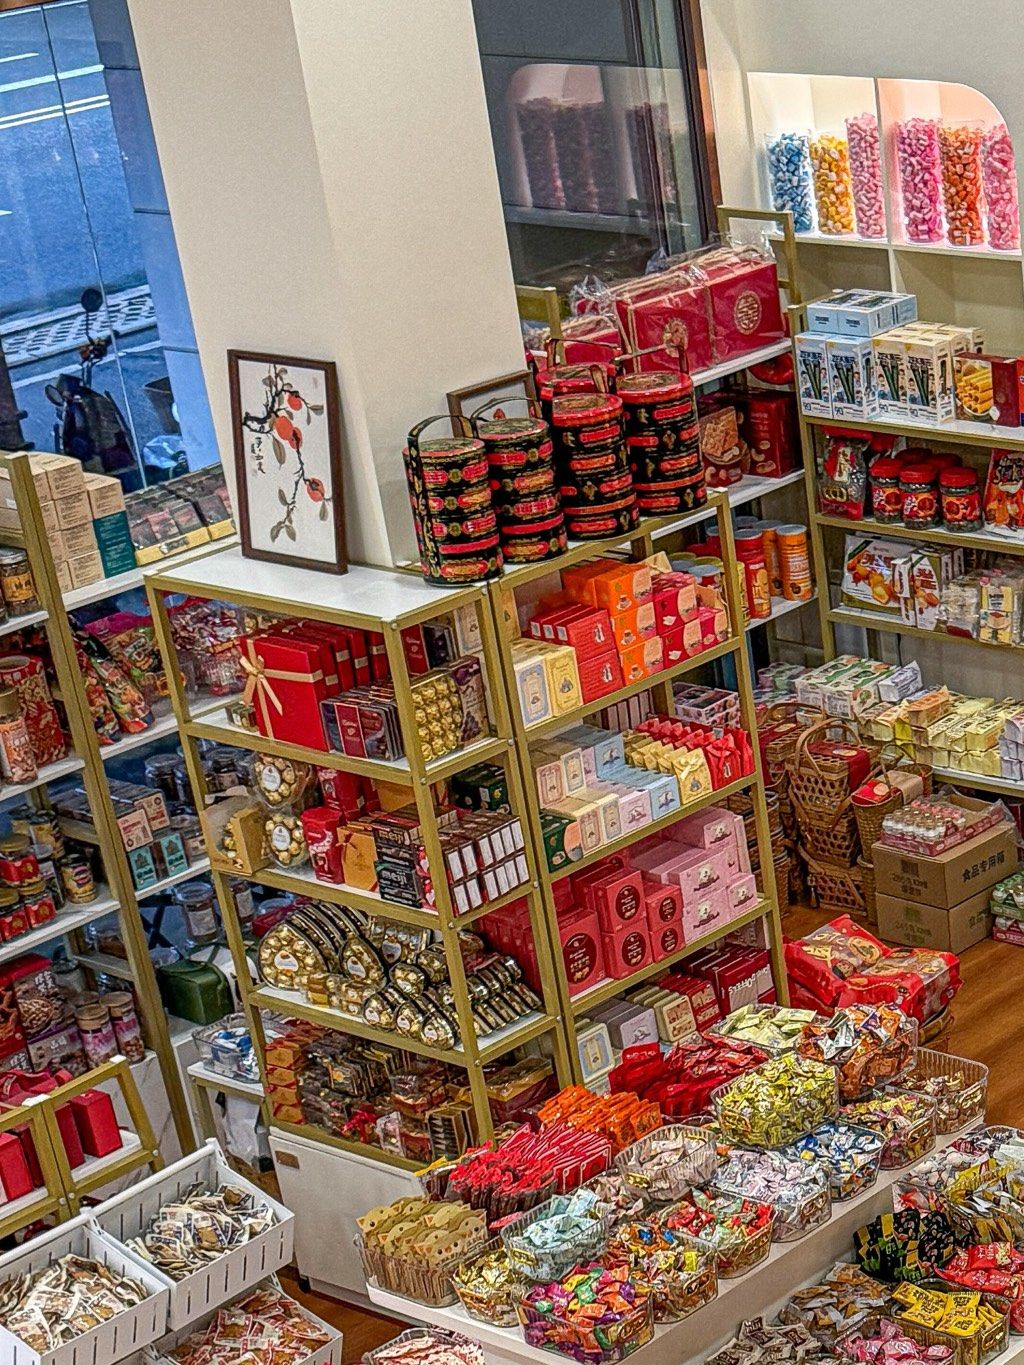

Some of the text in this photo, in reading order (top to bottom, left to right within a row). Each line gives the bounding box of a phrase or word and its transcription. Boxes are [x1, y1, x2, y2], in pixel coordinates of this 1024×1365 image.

[962, 851, 1005, 882] 食品专用箱
